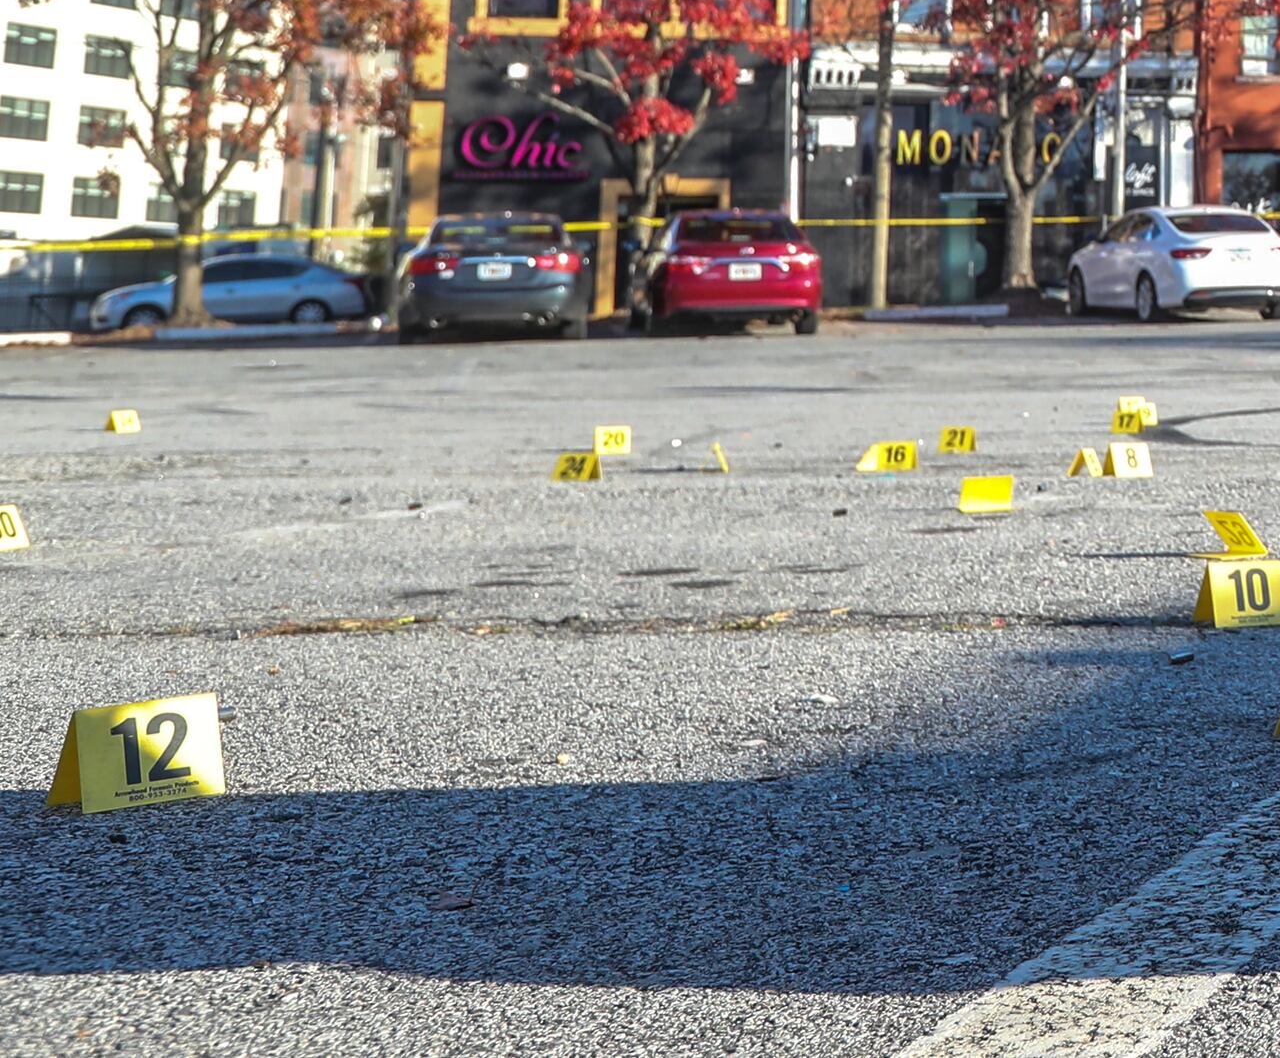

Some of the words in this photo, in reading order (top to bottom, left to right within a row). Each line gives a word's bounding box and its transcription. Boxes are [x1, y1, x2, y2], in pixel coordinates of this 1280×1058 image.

[461, 111, 587, 169] Chic
[1117, 414, 1135, 429] 17
[602, 432, 625, 447] 20
[946, 429, 967, 447] 21
[884, 445, 905, 463] 16
[1125, 447, 1138, 468] 8
[0, 511, 16, 539] 0
[1228, 568, 1271, 612] 10
[110, 712, 191, 785] 12
[114, 786, 147, 798] Arrowhead
[149, 783, 173, 793] Forensic
[175, 779, 200, 788] Products
[128, 788, 187, 802] 800-953-3274
